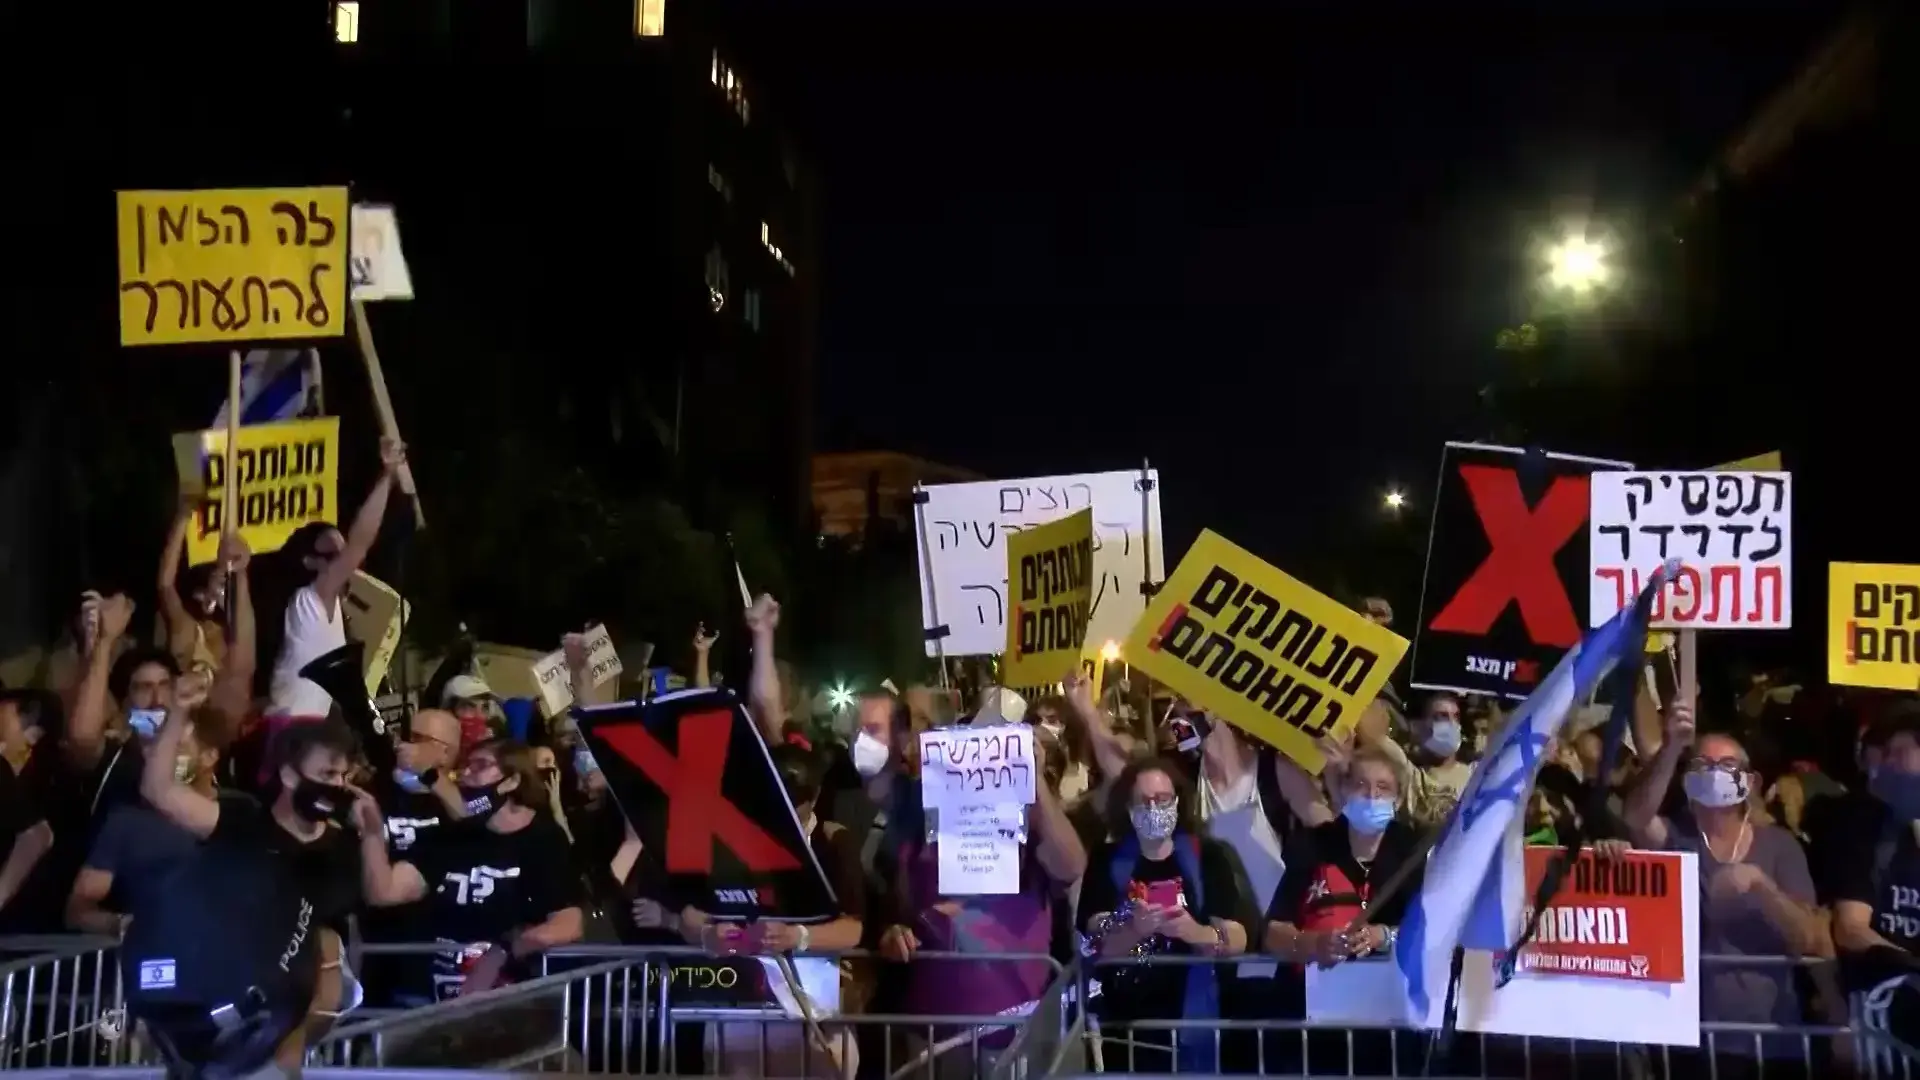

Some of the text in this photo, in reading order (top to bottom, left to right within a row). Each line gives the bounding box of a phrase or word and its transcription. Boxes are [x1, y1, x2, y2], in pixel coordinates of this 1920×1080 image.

[136, 201, 336, 275] זה הזמן
[121, 263, 331, 333] להתעורר
[202, 438, 325, 492] מנותקם
[1000, 483, 1092, 513] רוצים
[1623, 475, 1785, 521] תפסיק
[1598, 516, 1782, 562] לדרדר
[1190, 564, 1379, 696] מנותקים
[1846, 621, 1920, 665] תם!
[279, 897, 313, 972] POLICE
